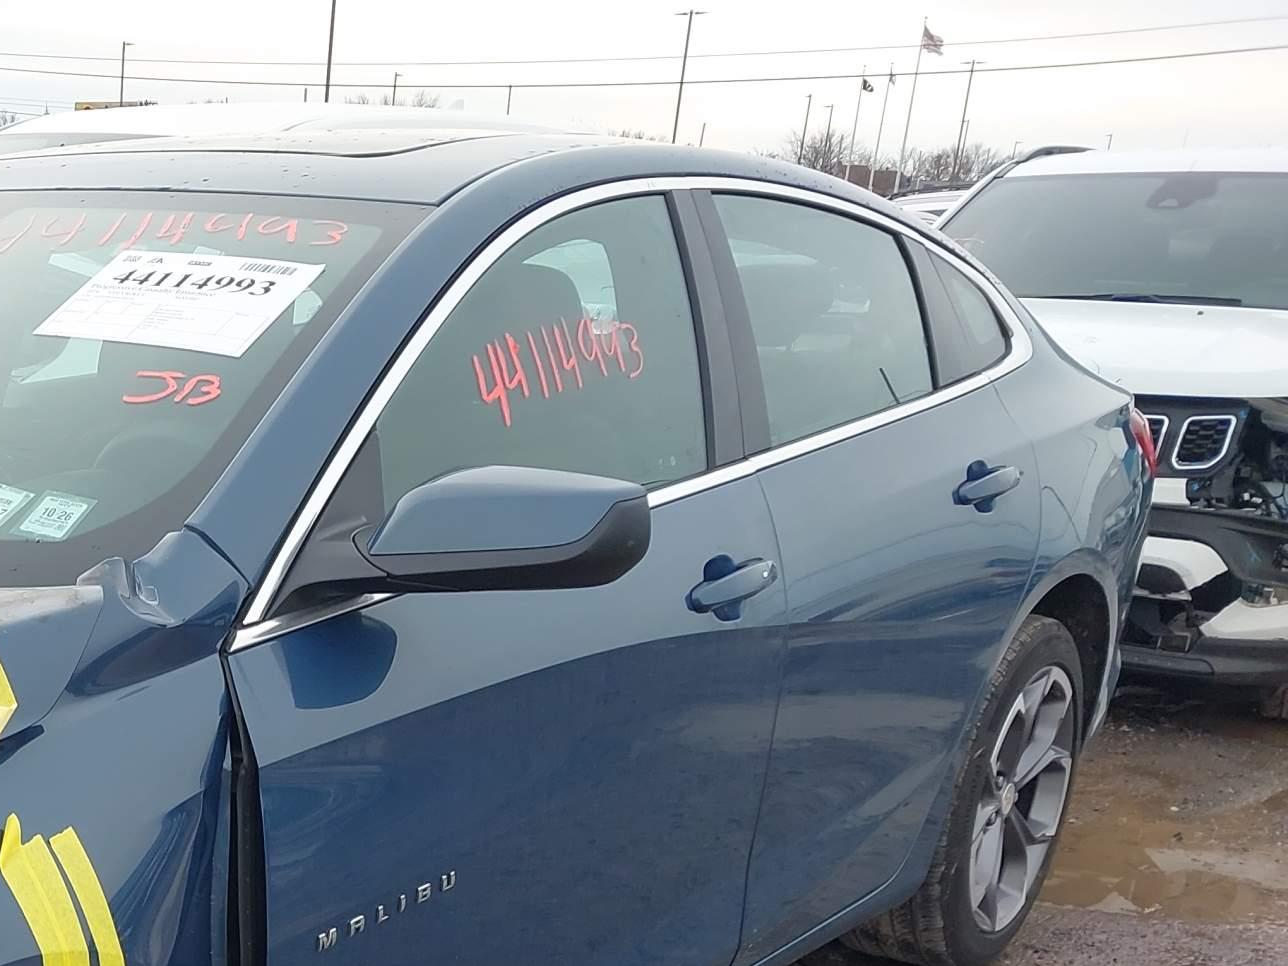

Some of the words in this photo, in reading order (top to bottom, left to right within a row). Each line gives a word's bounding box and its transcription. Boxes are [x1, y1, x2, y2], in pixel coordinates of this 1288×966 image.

[112, 268, 277, 296] 44114993
[121, 370, 223, 407] JB
[472, 316, 644, 427] 44114993
[42, 507, 57, 518] 10
[56, 510, 74, 521] 26
[316, 869, 458, 954] MALIBU
